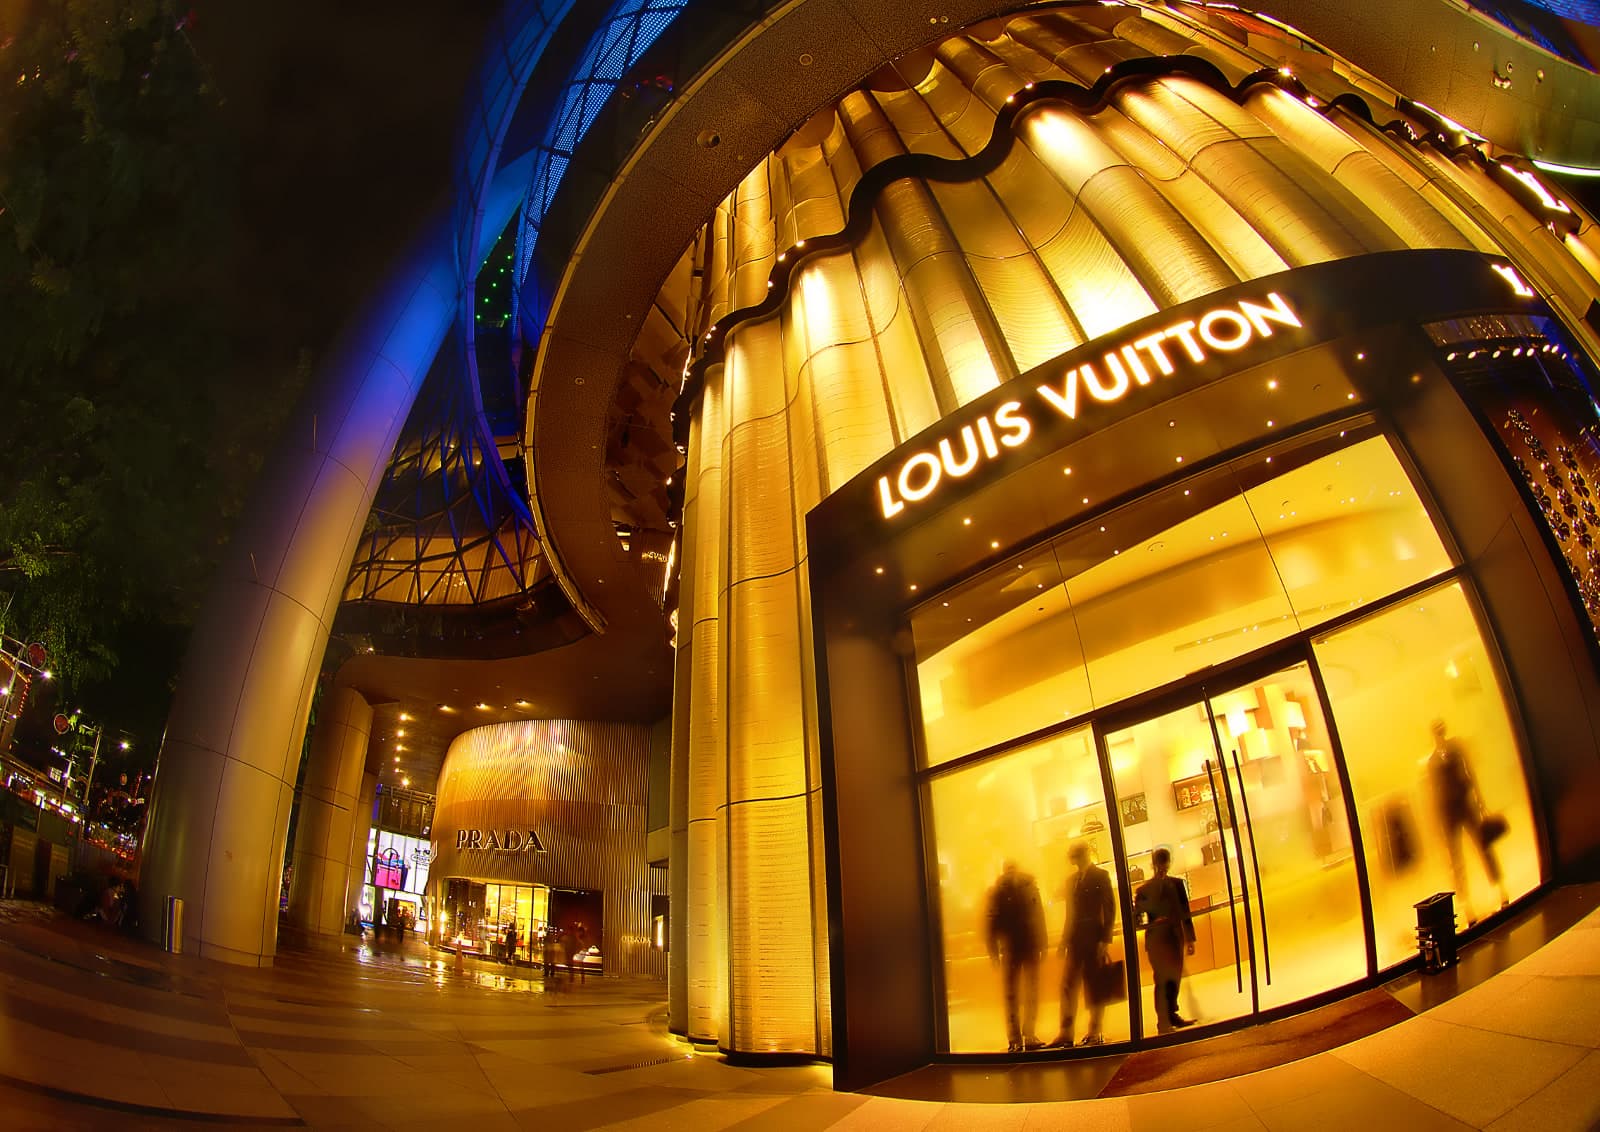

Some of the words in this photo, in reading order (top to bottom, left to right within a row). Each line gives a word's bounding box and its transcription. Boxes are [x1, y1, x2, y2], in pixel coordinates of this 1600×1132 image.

[877, 401, 1031, 519] LOUIS
[1036, 292, 1303, 420] VUITTON
[456, 829, 547, 853] PRADA
